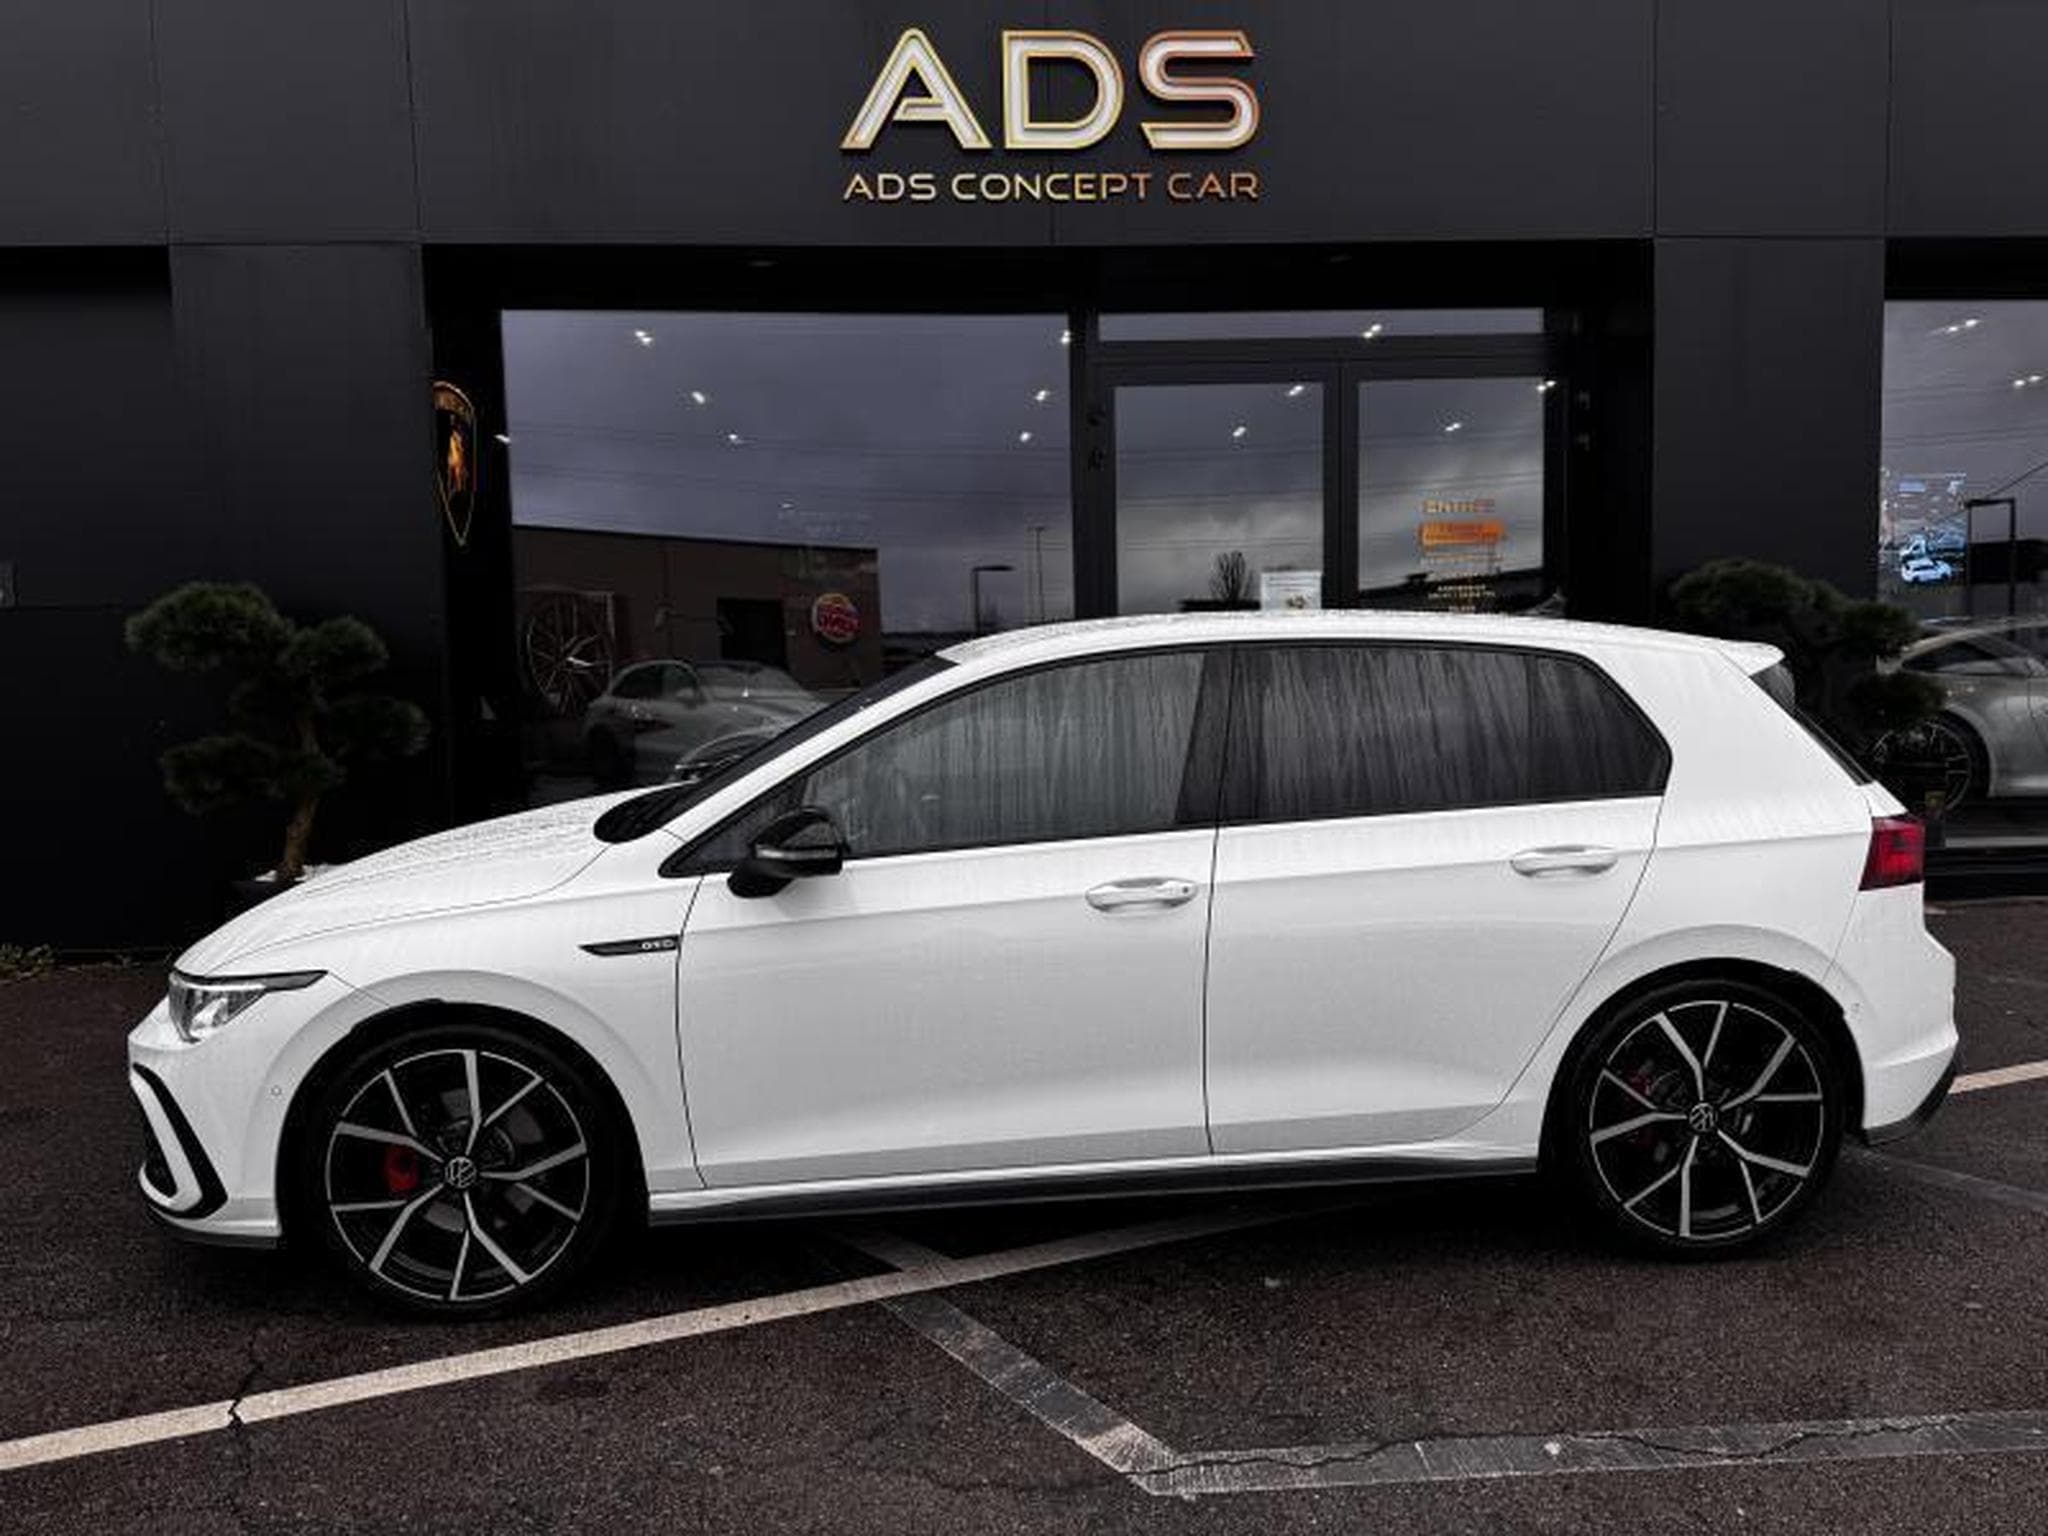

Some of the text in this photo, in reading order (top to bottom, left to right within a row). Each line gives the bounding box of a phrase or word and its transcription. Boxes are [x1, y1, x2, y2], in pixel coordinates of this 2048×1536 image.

[840, 28, 1260, 149] ADS
[843, 172, 1259, 201] ADS CONCEPT CAR
